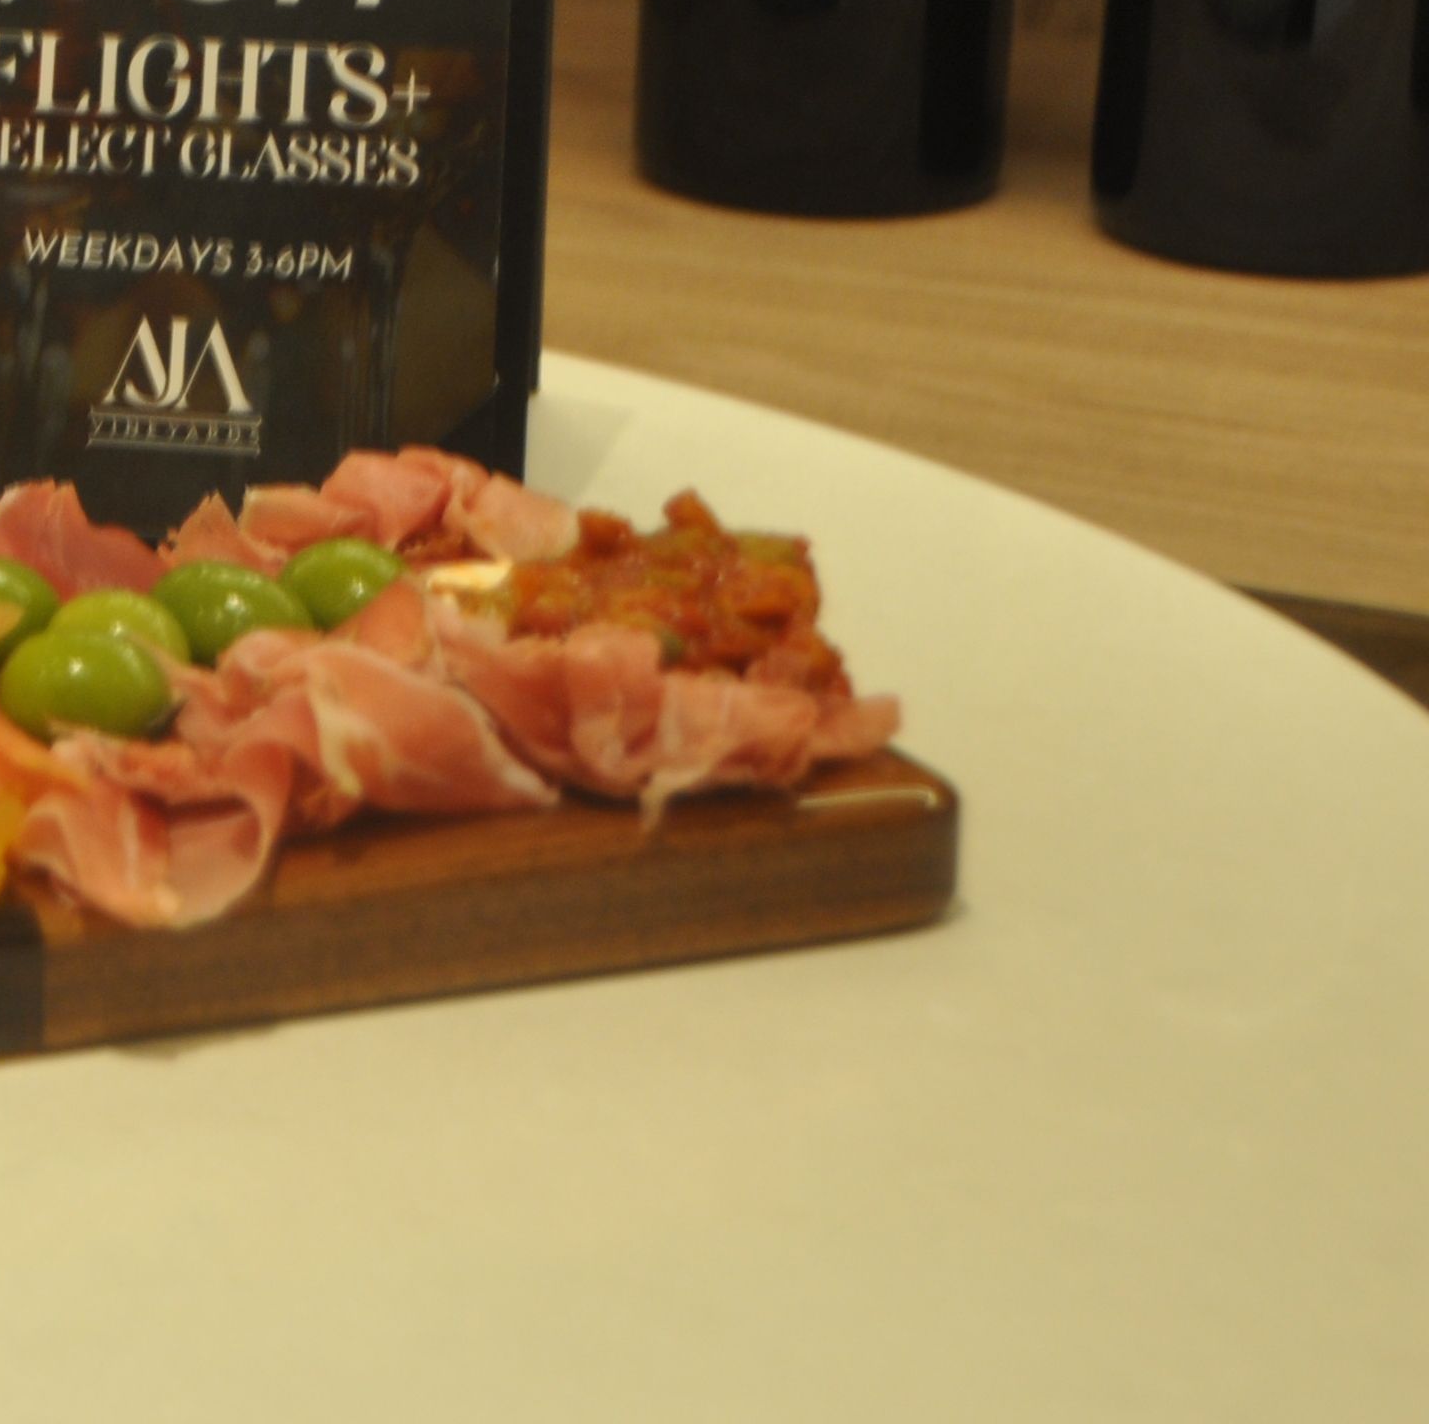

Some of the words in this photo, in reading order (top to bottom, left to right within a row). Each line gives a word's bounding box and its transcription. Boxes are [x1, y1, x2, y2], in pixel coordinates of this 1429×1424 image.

[179, 125, 420, 188] GLASSES
[23, 226, 234, 277] WEEKDAYS
[245, 241, 355, 283] 3-6PM
[101, 313, 253, 412] AJA
